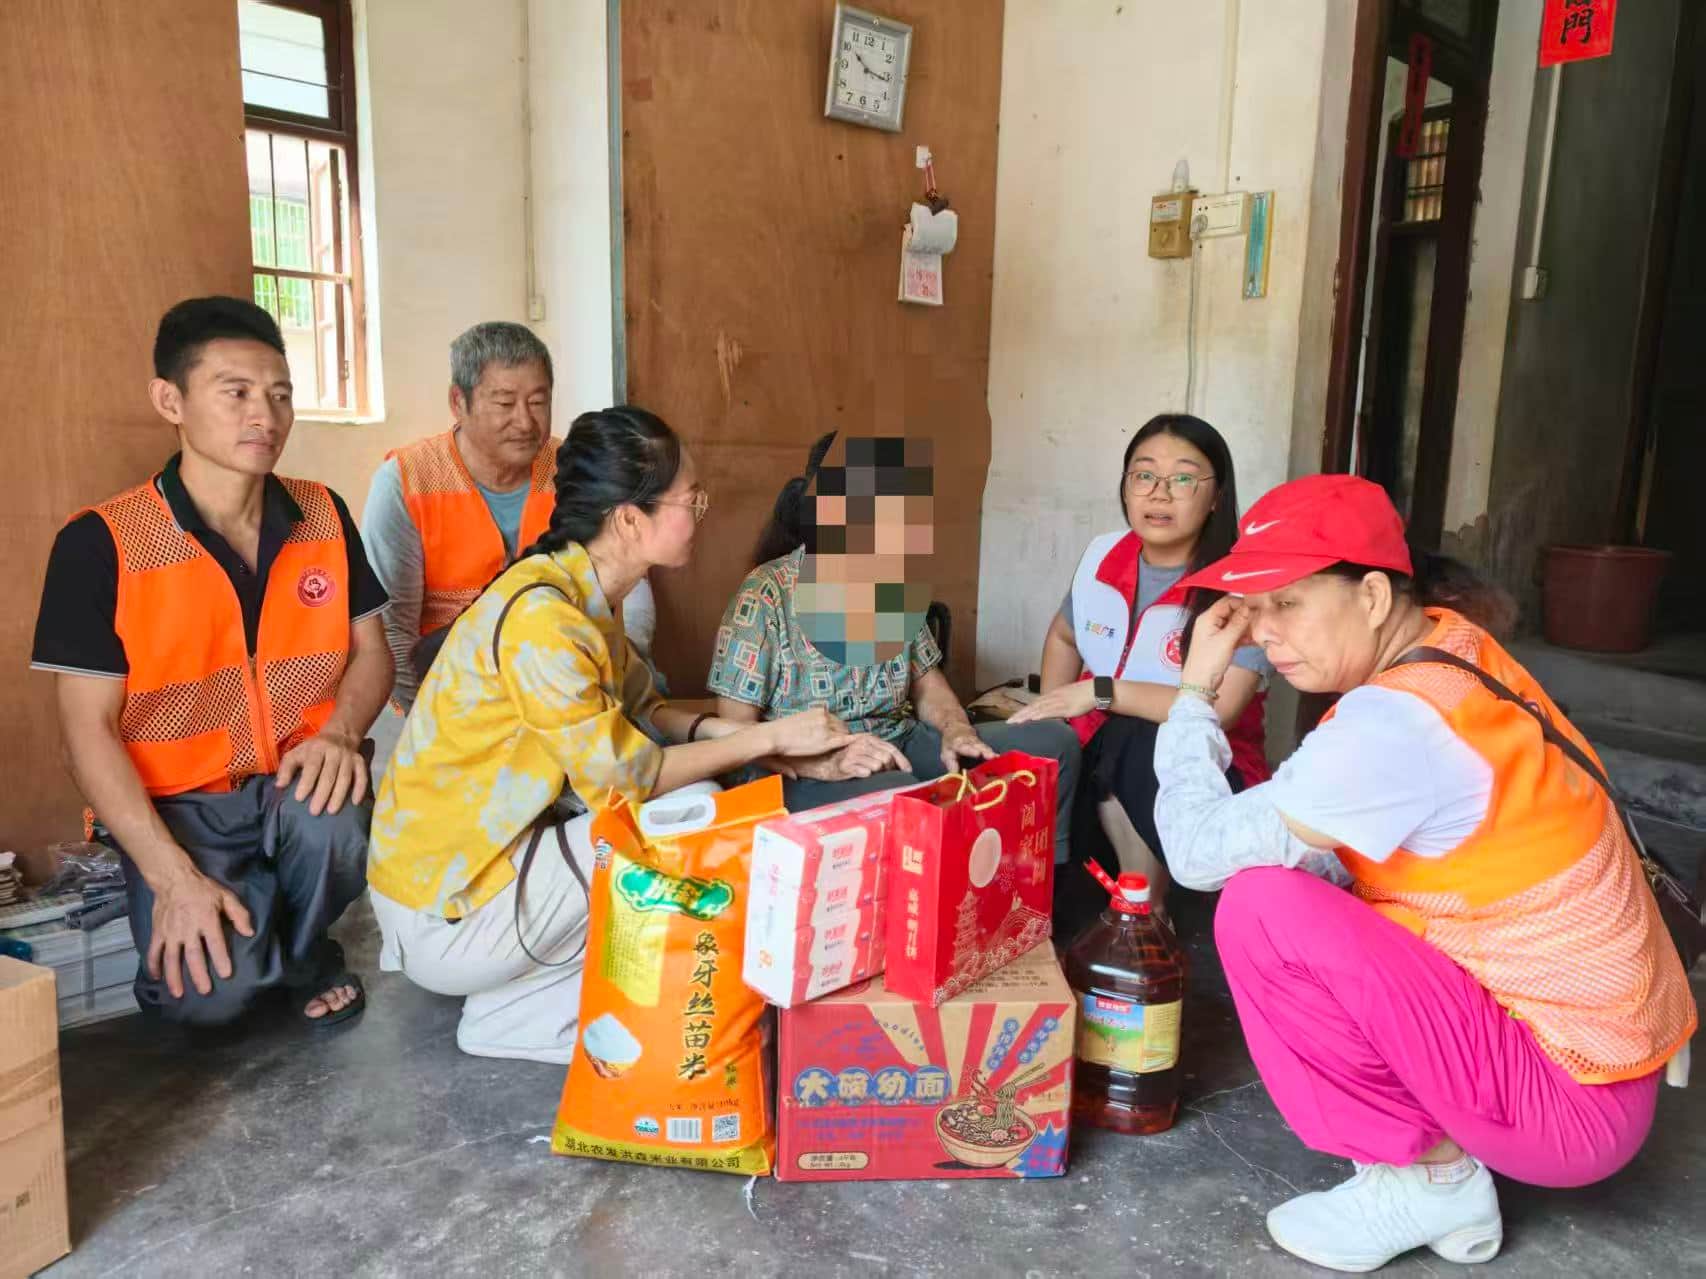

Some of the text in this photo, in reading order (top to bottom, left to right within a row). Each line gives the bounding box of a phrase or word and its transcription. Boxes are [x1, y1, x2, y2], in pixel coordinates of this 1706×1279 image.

[1560, 0, 1593, 44] 門
[678, 931, 720, 1080] 象牙丝苗米
[799, 1071, 946, 1100] 大碗幼面
